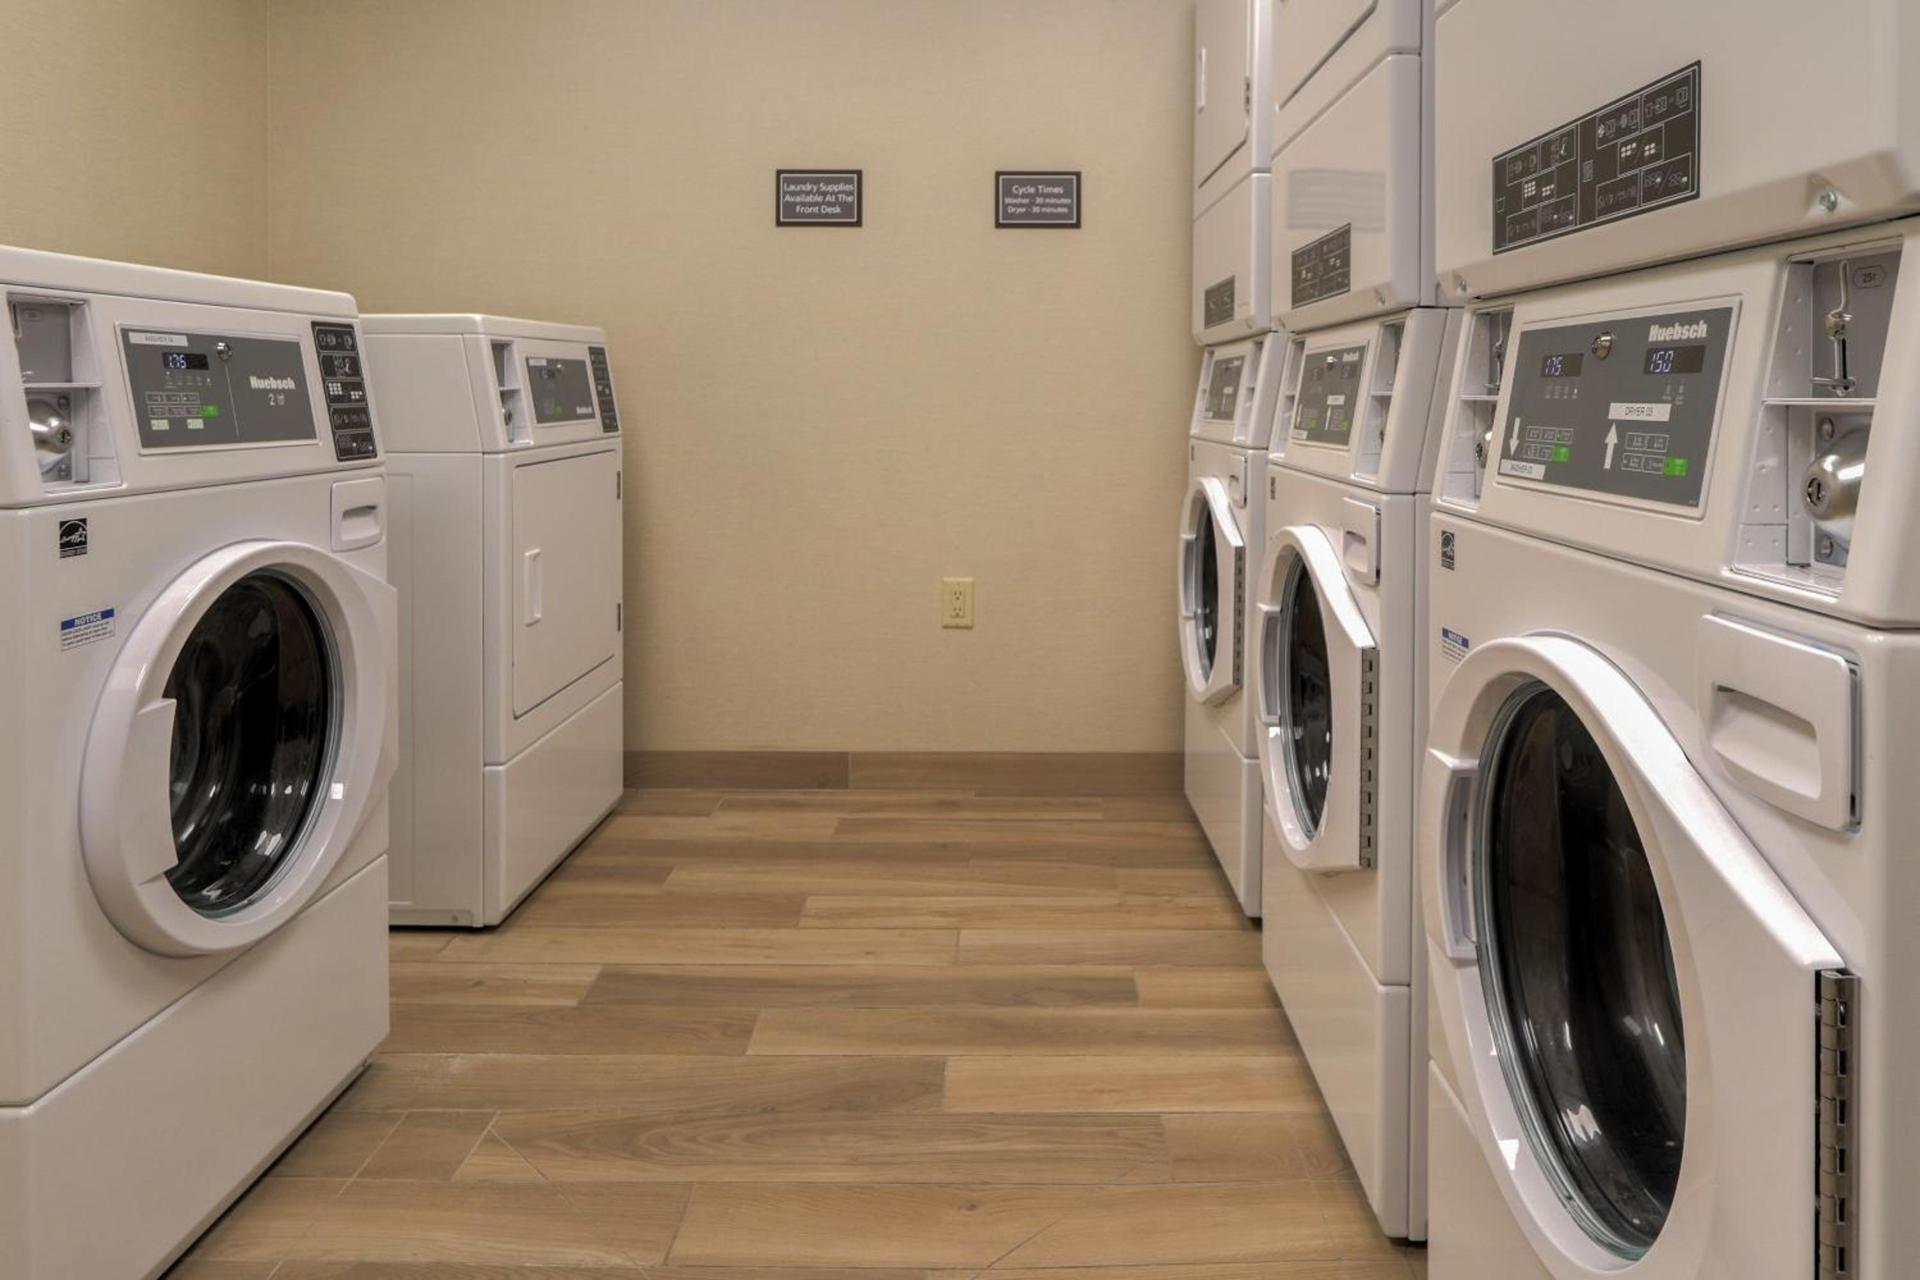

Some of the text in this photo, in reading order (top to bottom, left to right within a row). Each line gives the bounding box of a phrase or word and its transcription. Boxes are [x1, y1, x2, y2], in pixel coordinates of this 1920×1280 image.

[784, 182, 854, 193] Laundry Supplies
[1012, 184, 1064, 195] Cycle Times
[784, 194, 854, 203] Available At The
[796, 205, 842, 214] Front Desk
[1007, 206, 1027, 214] Dryer
[1042, 206, 1068, 214] minutes
[1648, 320, 1708, 342] Huebsch
[249, 375, 296, 390] Huebsch
[74, 612, 103, 627] NOTICE
